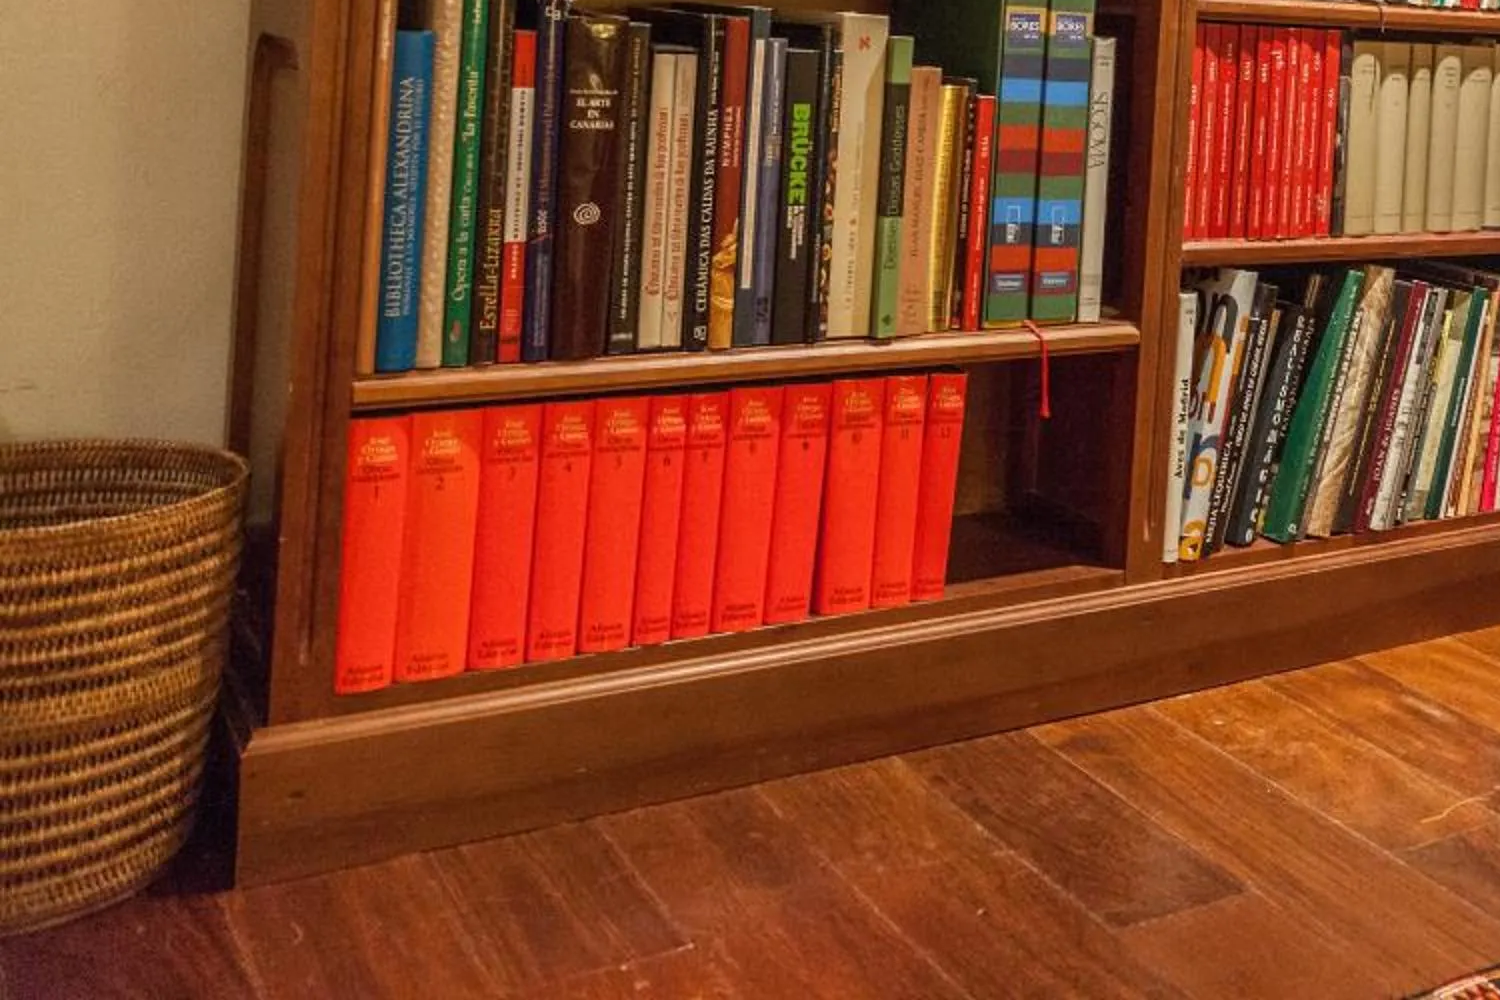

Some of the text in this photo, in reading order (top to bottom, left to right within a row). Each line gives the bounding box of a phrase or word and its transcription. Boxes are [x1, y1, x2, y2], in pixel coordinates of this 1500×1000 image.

[787, 103, 813, 204] BRÜCKE
[889, 104, 905, 173] Goddesses
[384, 77, 415, 318] BIBLIOTHECA ALEXANDRINA
[1174, 379, 1190, 479] Aves de Madrid
[1372, 449, 1388, 481] JOAN
